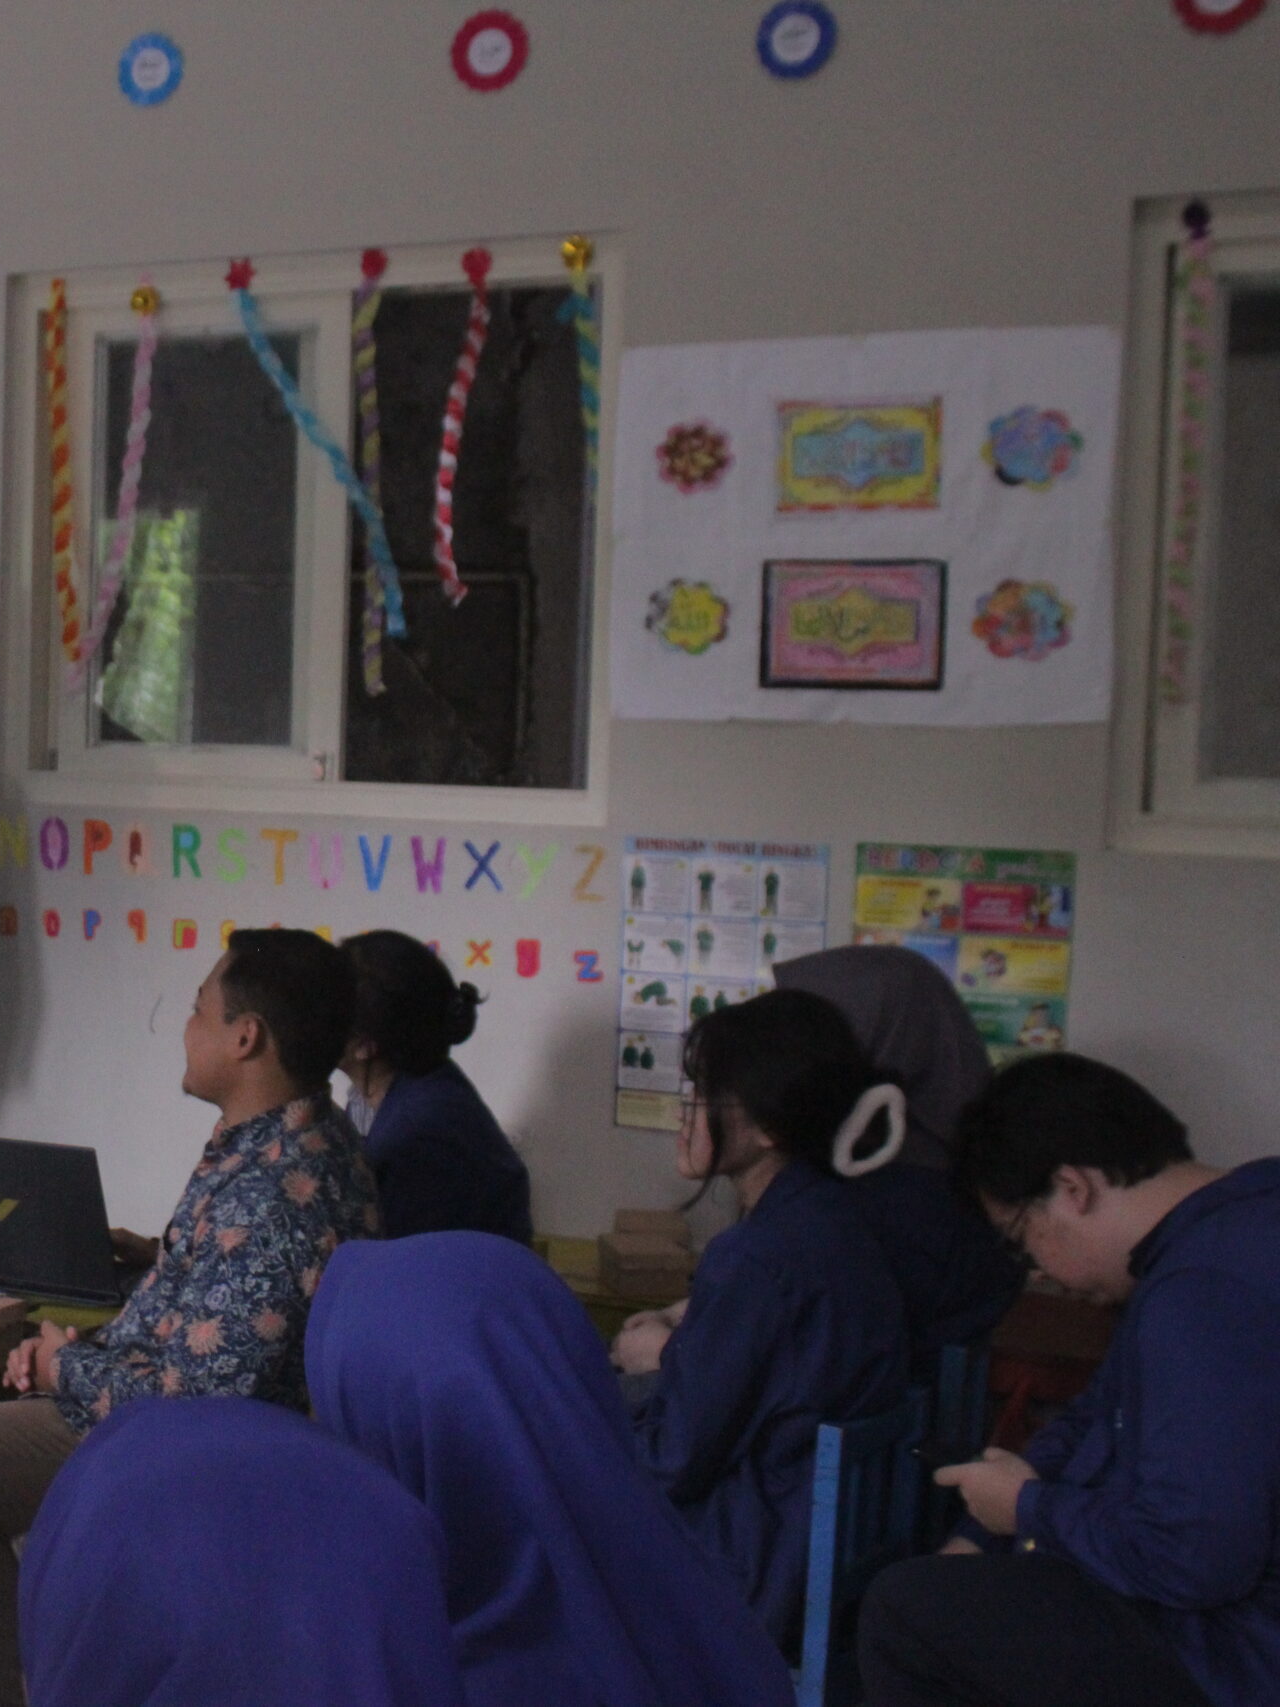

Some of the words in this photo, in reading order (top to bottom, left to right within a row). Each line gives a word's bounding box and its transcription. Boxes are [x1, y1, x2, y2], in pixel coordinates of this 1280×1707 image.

[39, 816, 69, 871] O
[83, 819, 113, 875] P
[172, 823, 202, 878] R
[216, 827, 249, 883] S
[261, 828, 298, 886] T
[308, 832, 343, 889] U
[358, 835, 392, 891] V
[410, 836, 446, 894] W
[463, 840, 503, 892] X
[518, 843, 560, 898] Y
[574, 844, 606, 902] Z
